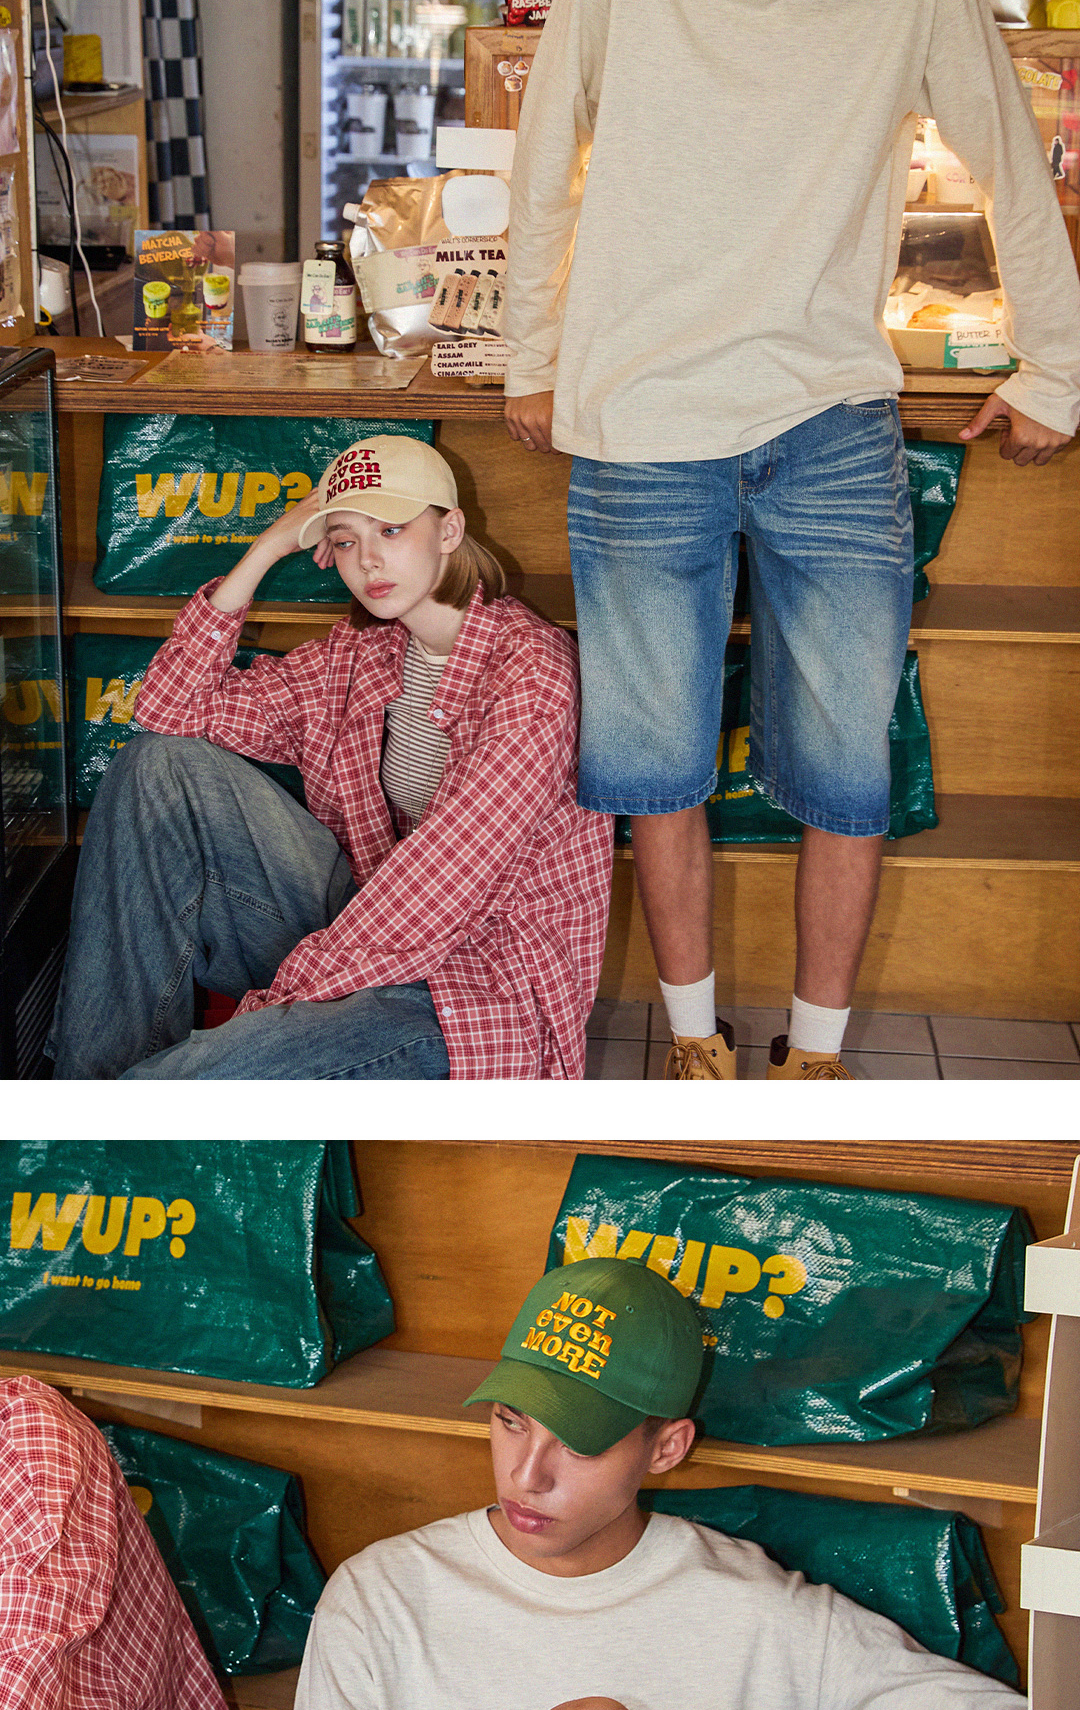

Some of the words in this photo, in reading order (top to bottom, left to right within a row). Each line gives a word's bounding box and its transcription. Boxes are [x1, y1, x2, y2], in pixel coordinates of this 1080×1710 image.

[142, 236, 182, 250] MATCHA
[139, 247, 192, 265] BEVERAGE
[436, 250, 475, 262] MILK
[479, 249, 506, 261] TEA
[956, 330, 991, 341] BUTTER
[333, 449, 376, 471] NOT
[329, 462, 381, 485] even
[135, 472, 312, 519] WUP?
[326, 474, 382, 504] MORE
[202, 533, 213, 543] to
[215, 534, 228, 545] go
[10, 1192, 196, 1259] WUP?
[43, 1271, 49, 1284] I
[51, 1275, 81, 1287] want
[82, 1275, 94, 1288] to
[95, 1277, 110, 1291] go
[112, 1275, 141, 1291] home
[551, 1291, 617, 1330] NOT
[536, 1308, 613, 1357] even
[521, 1327, 607, 1380] MORE
